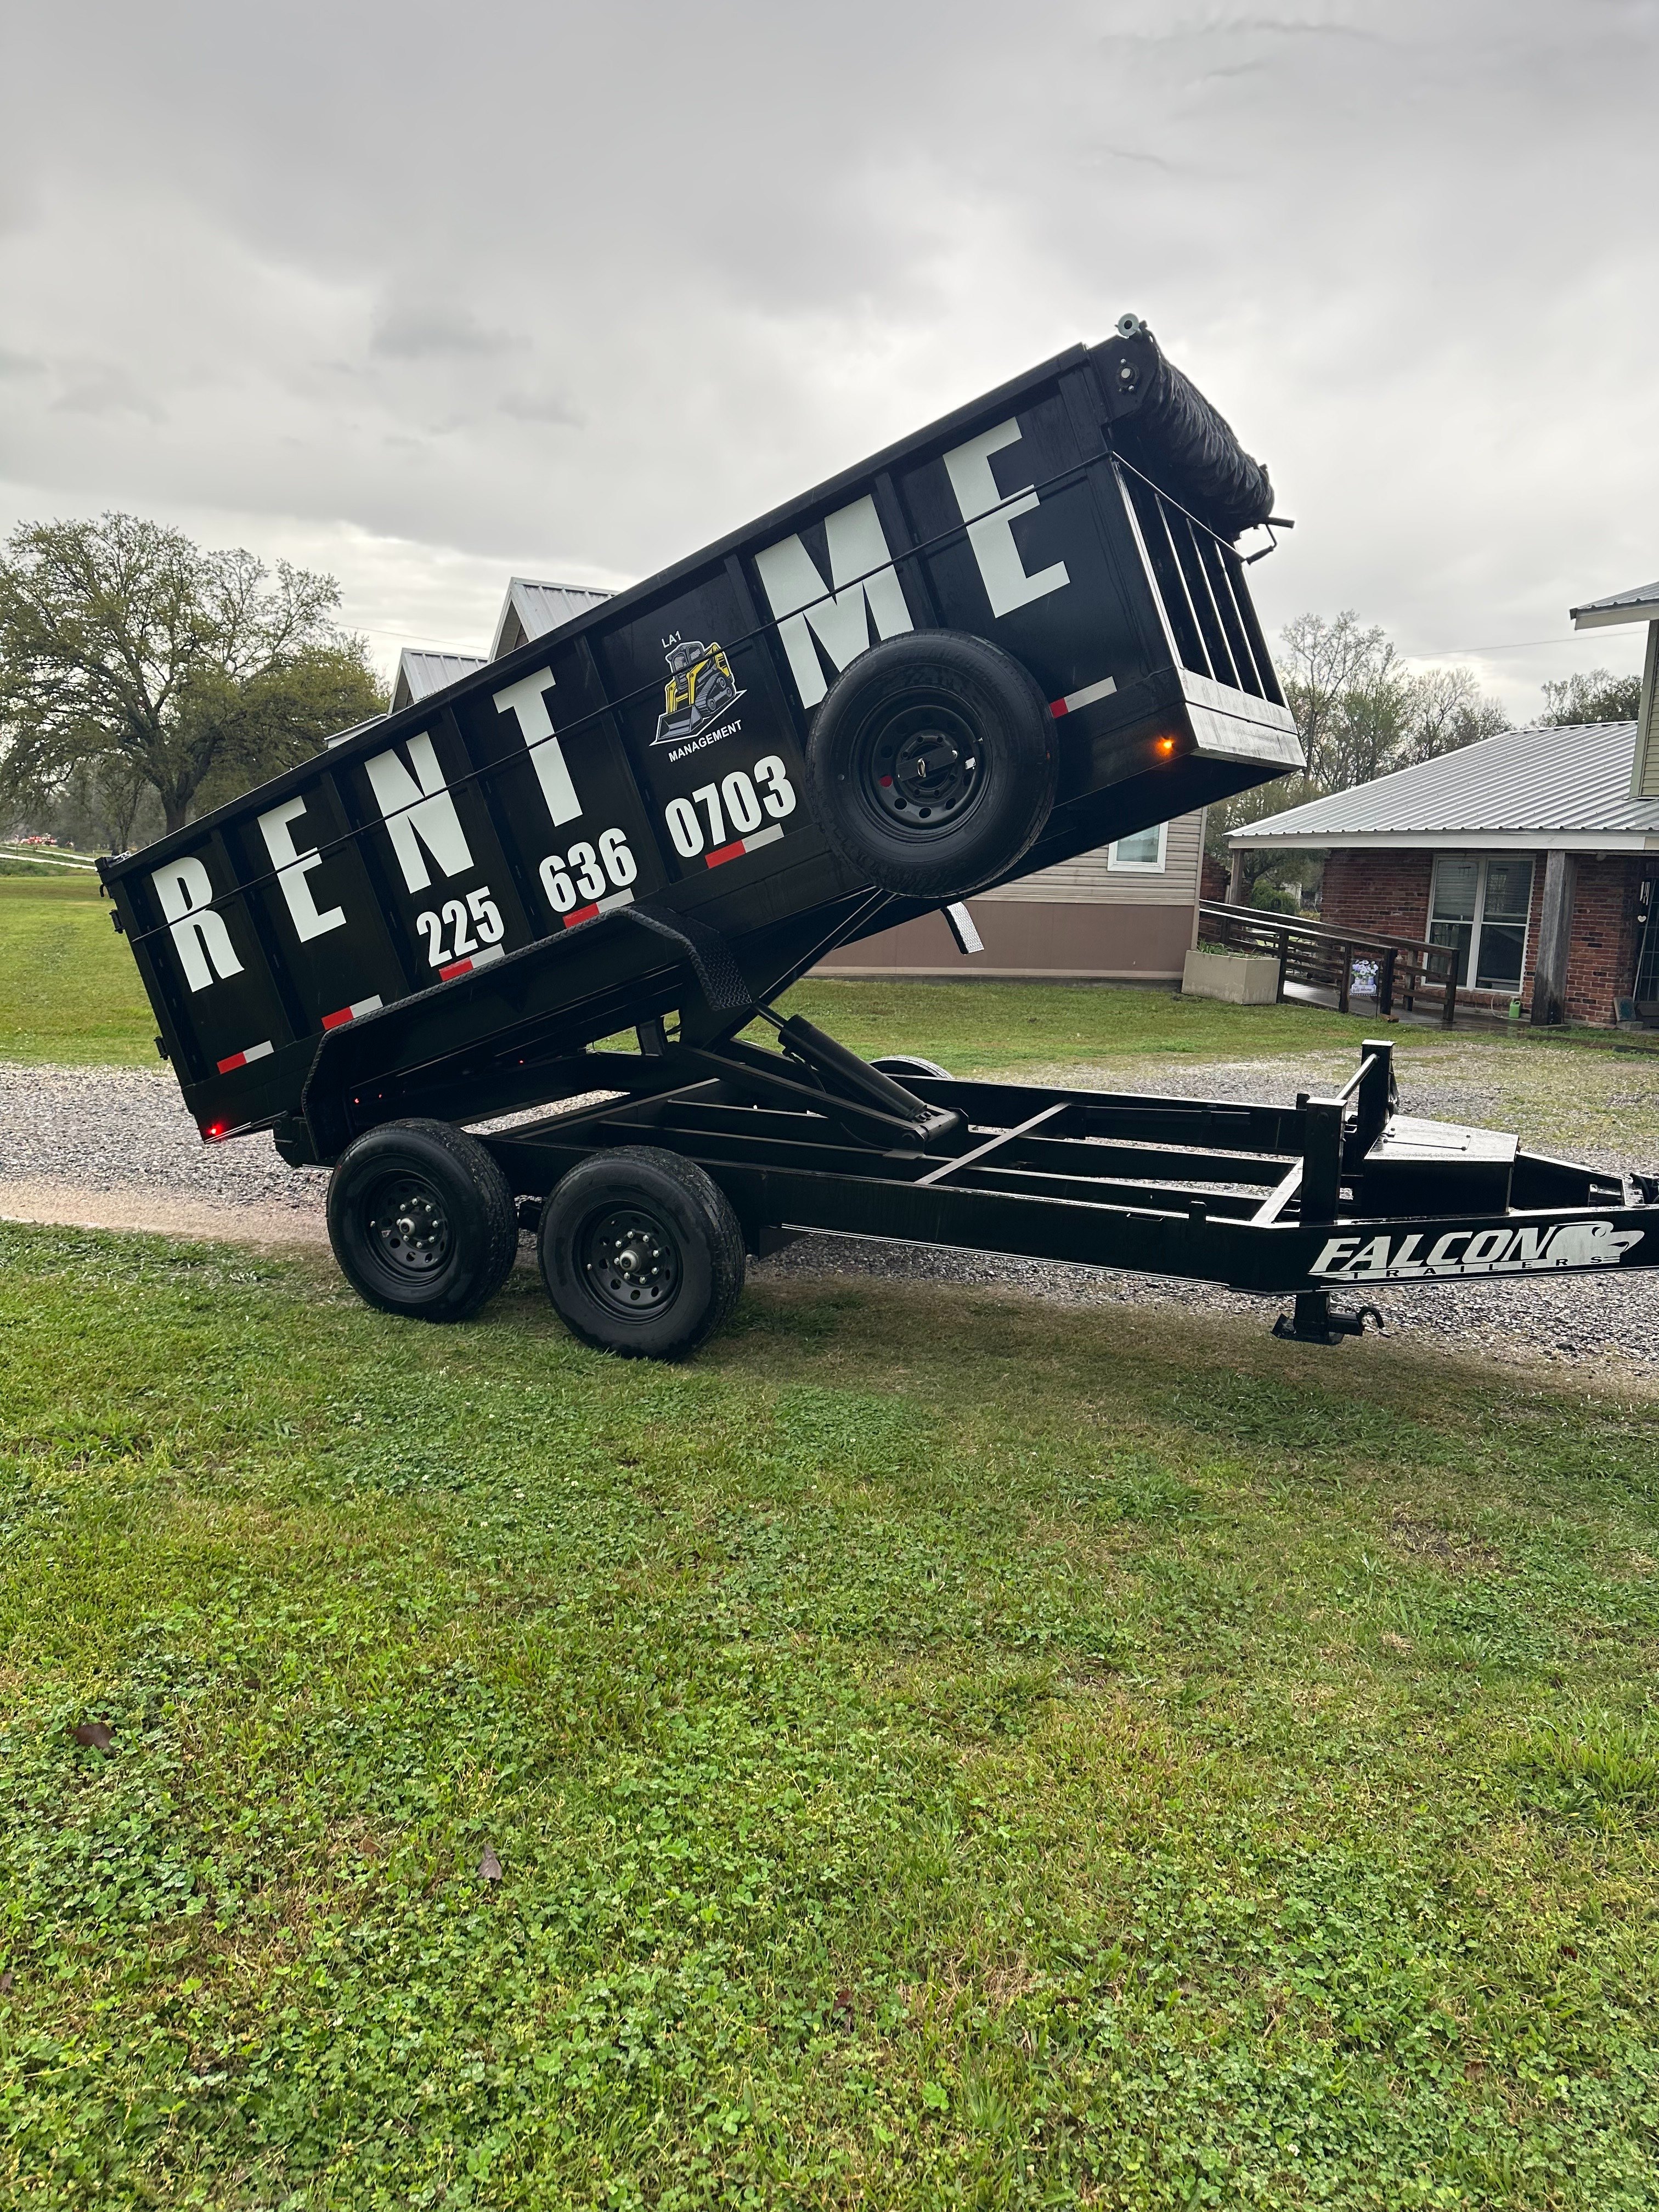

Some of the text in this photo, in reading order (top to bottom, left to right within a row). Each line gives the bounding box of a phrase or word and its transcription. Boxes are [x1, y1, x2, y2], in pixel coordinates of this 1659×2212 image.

[661, 630, 682, 649] LA1
[152, 416, 1071, 992] RENT ME
[668, 719, 742, 763] MANAGEMENT
[416, 755, 797, 968] 225 636 0703
[1308, 1226, 1558, 1274] FALCON
[1350, 1255, 1603, 1279] TRAILERS
